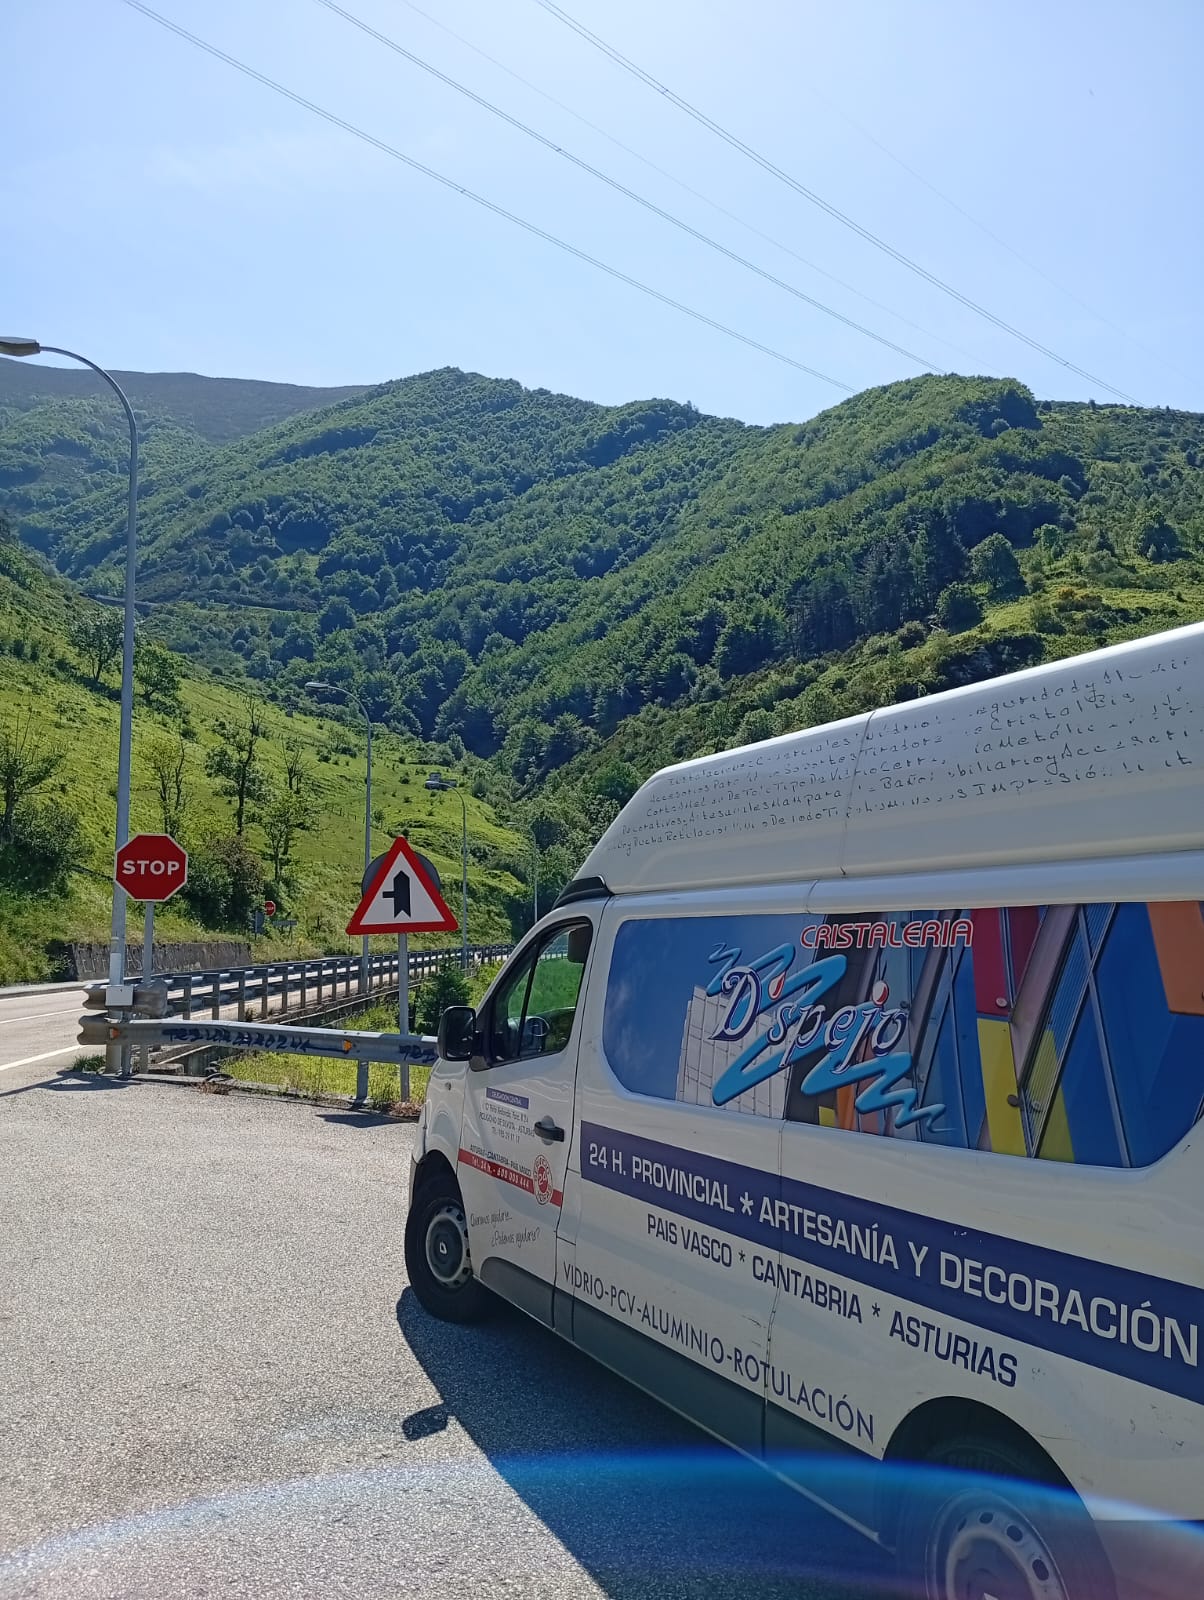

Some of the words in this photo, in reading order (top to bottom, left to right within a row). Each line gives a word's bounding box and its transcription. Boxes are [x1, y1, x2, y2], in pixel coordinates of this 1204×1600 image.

[122, 860, 180, 876] STOP
[800, 919, 974, 948] CRISTALERIA
[588, 1142, 607, 1169] 24
[612, 1150, 626, 1176] H.
[632, 1156, 735, 1214] PROVINCIAL
[759, 1197, 899, 1270] ARTESANÍA
[908, 1241, 929, 1277] Y
[940, 1250, 1198, 1367] DECORACIÓN
[647, 1213, 677, 1245] PAIS
[681, 1223, 732, 1268] VASCO
[752, 1255, 862, 1323] CANTABRIA
[889, 1311, 1018, 1387] ASTURIAS
